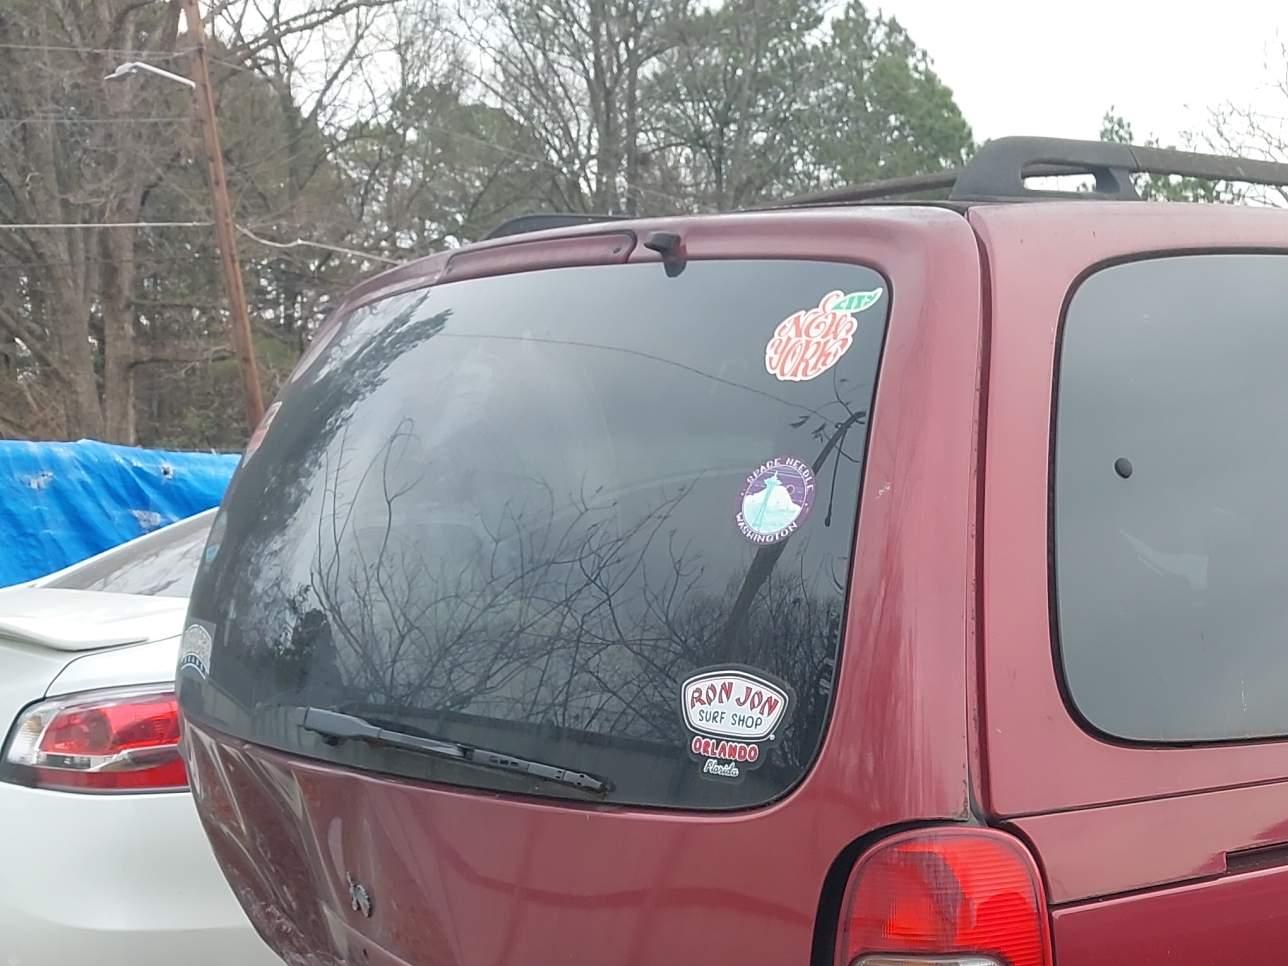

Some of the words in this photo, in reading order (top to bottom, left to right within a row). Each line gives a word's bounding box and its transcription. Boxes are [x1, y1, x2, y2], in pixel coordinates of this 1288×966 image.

[746, 457, 782, 483] SPACE
[785, 457, 815, 491] NEEDLE
[735, 511, 799, 543] WASHINGTON
[690, 681, 734, 710] RON
[735, 686, 780, 718] JON
[698, 709, 726, 725] SURF
[731, 713, 763, 730] SHOP
[691, 735, 760, 762] ORLANDO
[703, 759, 740, 777] Florida
